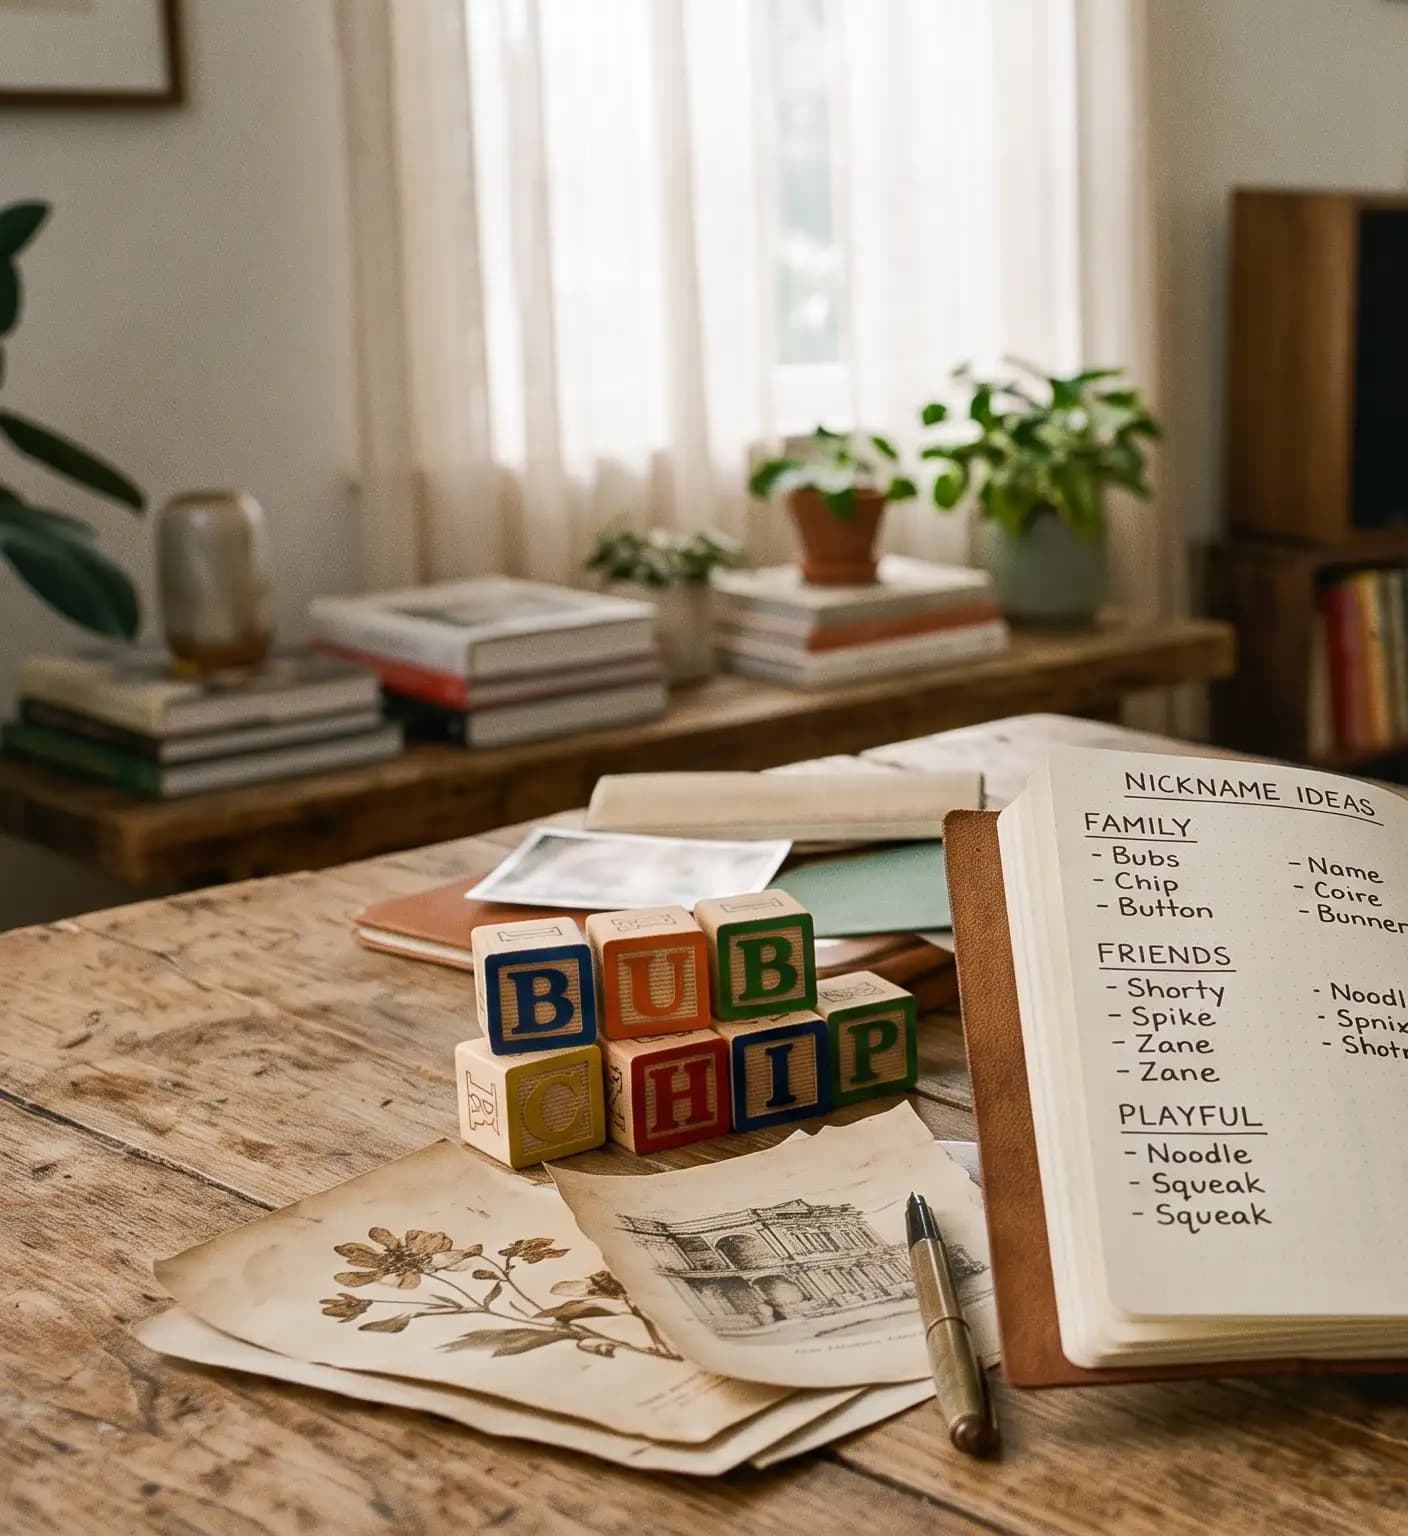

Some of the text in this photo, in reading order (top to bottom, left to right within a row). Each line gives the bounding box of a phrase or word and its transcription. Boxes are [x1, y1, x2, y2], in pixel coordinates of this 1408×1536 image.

[1124, 771, 1376, 817] NICKNAME IDEAS
[1084, 812, 1192, 838] FAMILY
[1111, 845, 1180, 868] Bubs
[1307, 856, 1385, 884] Name
[1114, 871, 1179, 898] Chip
[1313, 880, 1383, 907] Coire
[1118, 896, 1214, 919] Button
[1097, 942, 1232, 966] FRIENDS
[1127, 977, 1225, 1008] Shorty
[1131, 1005, 1217, 1033] Spike
[1135, 1033, 1215, 1055] Zane
[1138, 1060, 1221, 1083] Zane
[1118, 1103, 1264, 1127] PLAYFUL
[1147, 1141, 1253, 1165] Noodle
[1151, 1171, 1266, 1203] Squeak
[1155, 1202, 1273, 1235] Squeak
